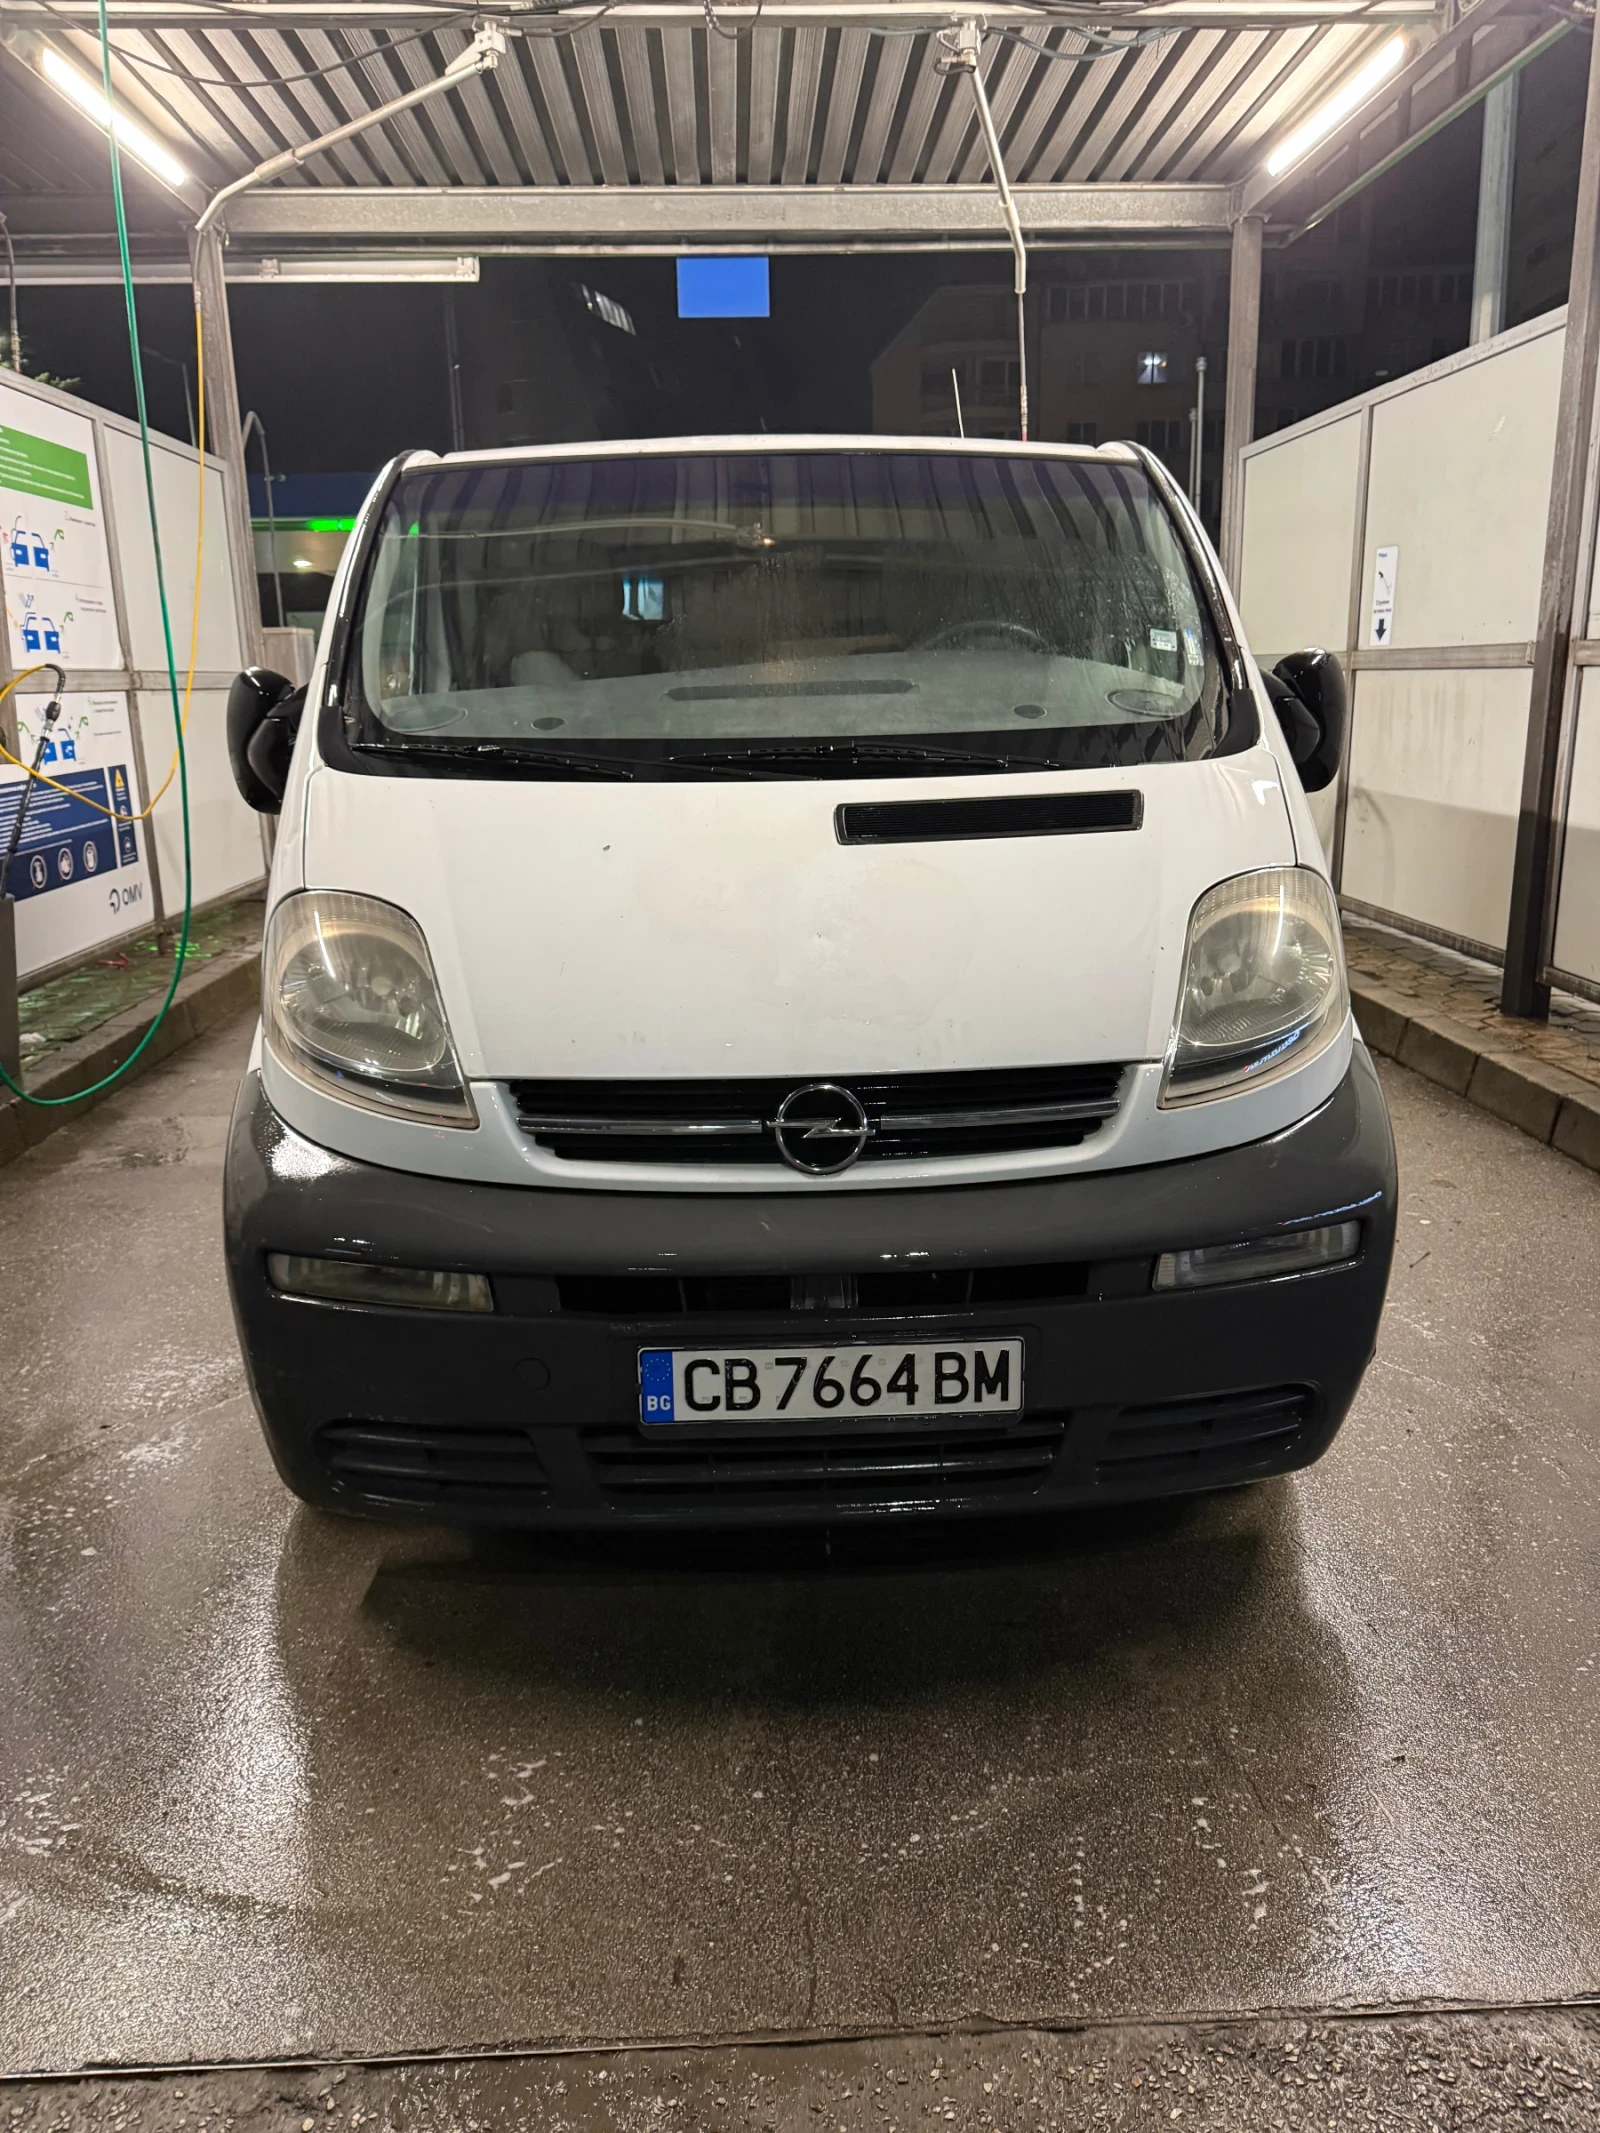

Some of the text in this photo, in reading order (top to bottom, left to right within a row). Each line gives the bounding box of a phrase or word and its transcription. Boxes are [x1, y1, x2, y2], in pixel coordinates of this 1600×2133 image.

[122, 882, 142, 905] OMV
[684, 1349, 1010, 1412] CB 7664 BM
[647, 1395, 671, 1411] BG
